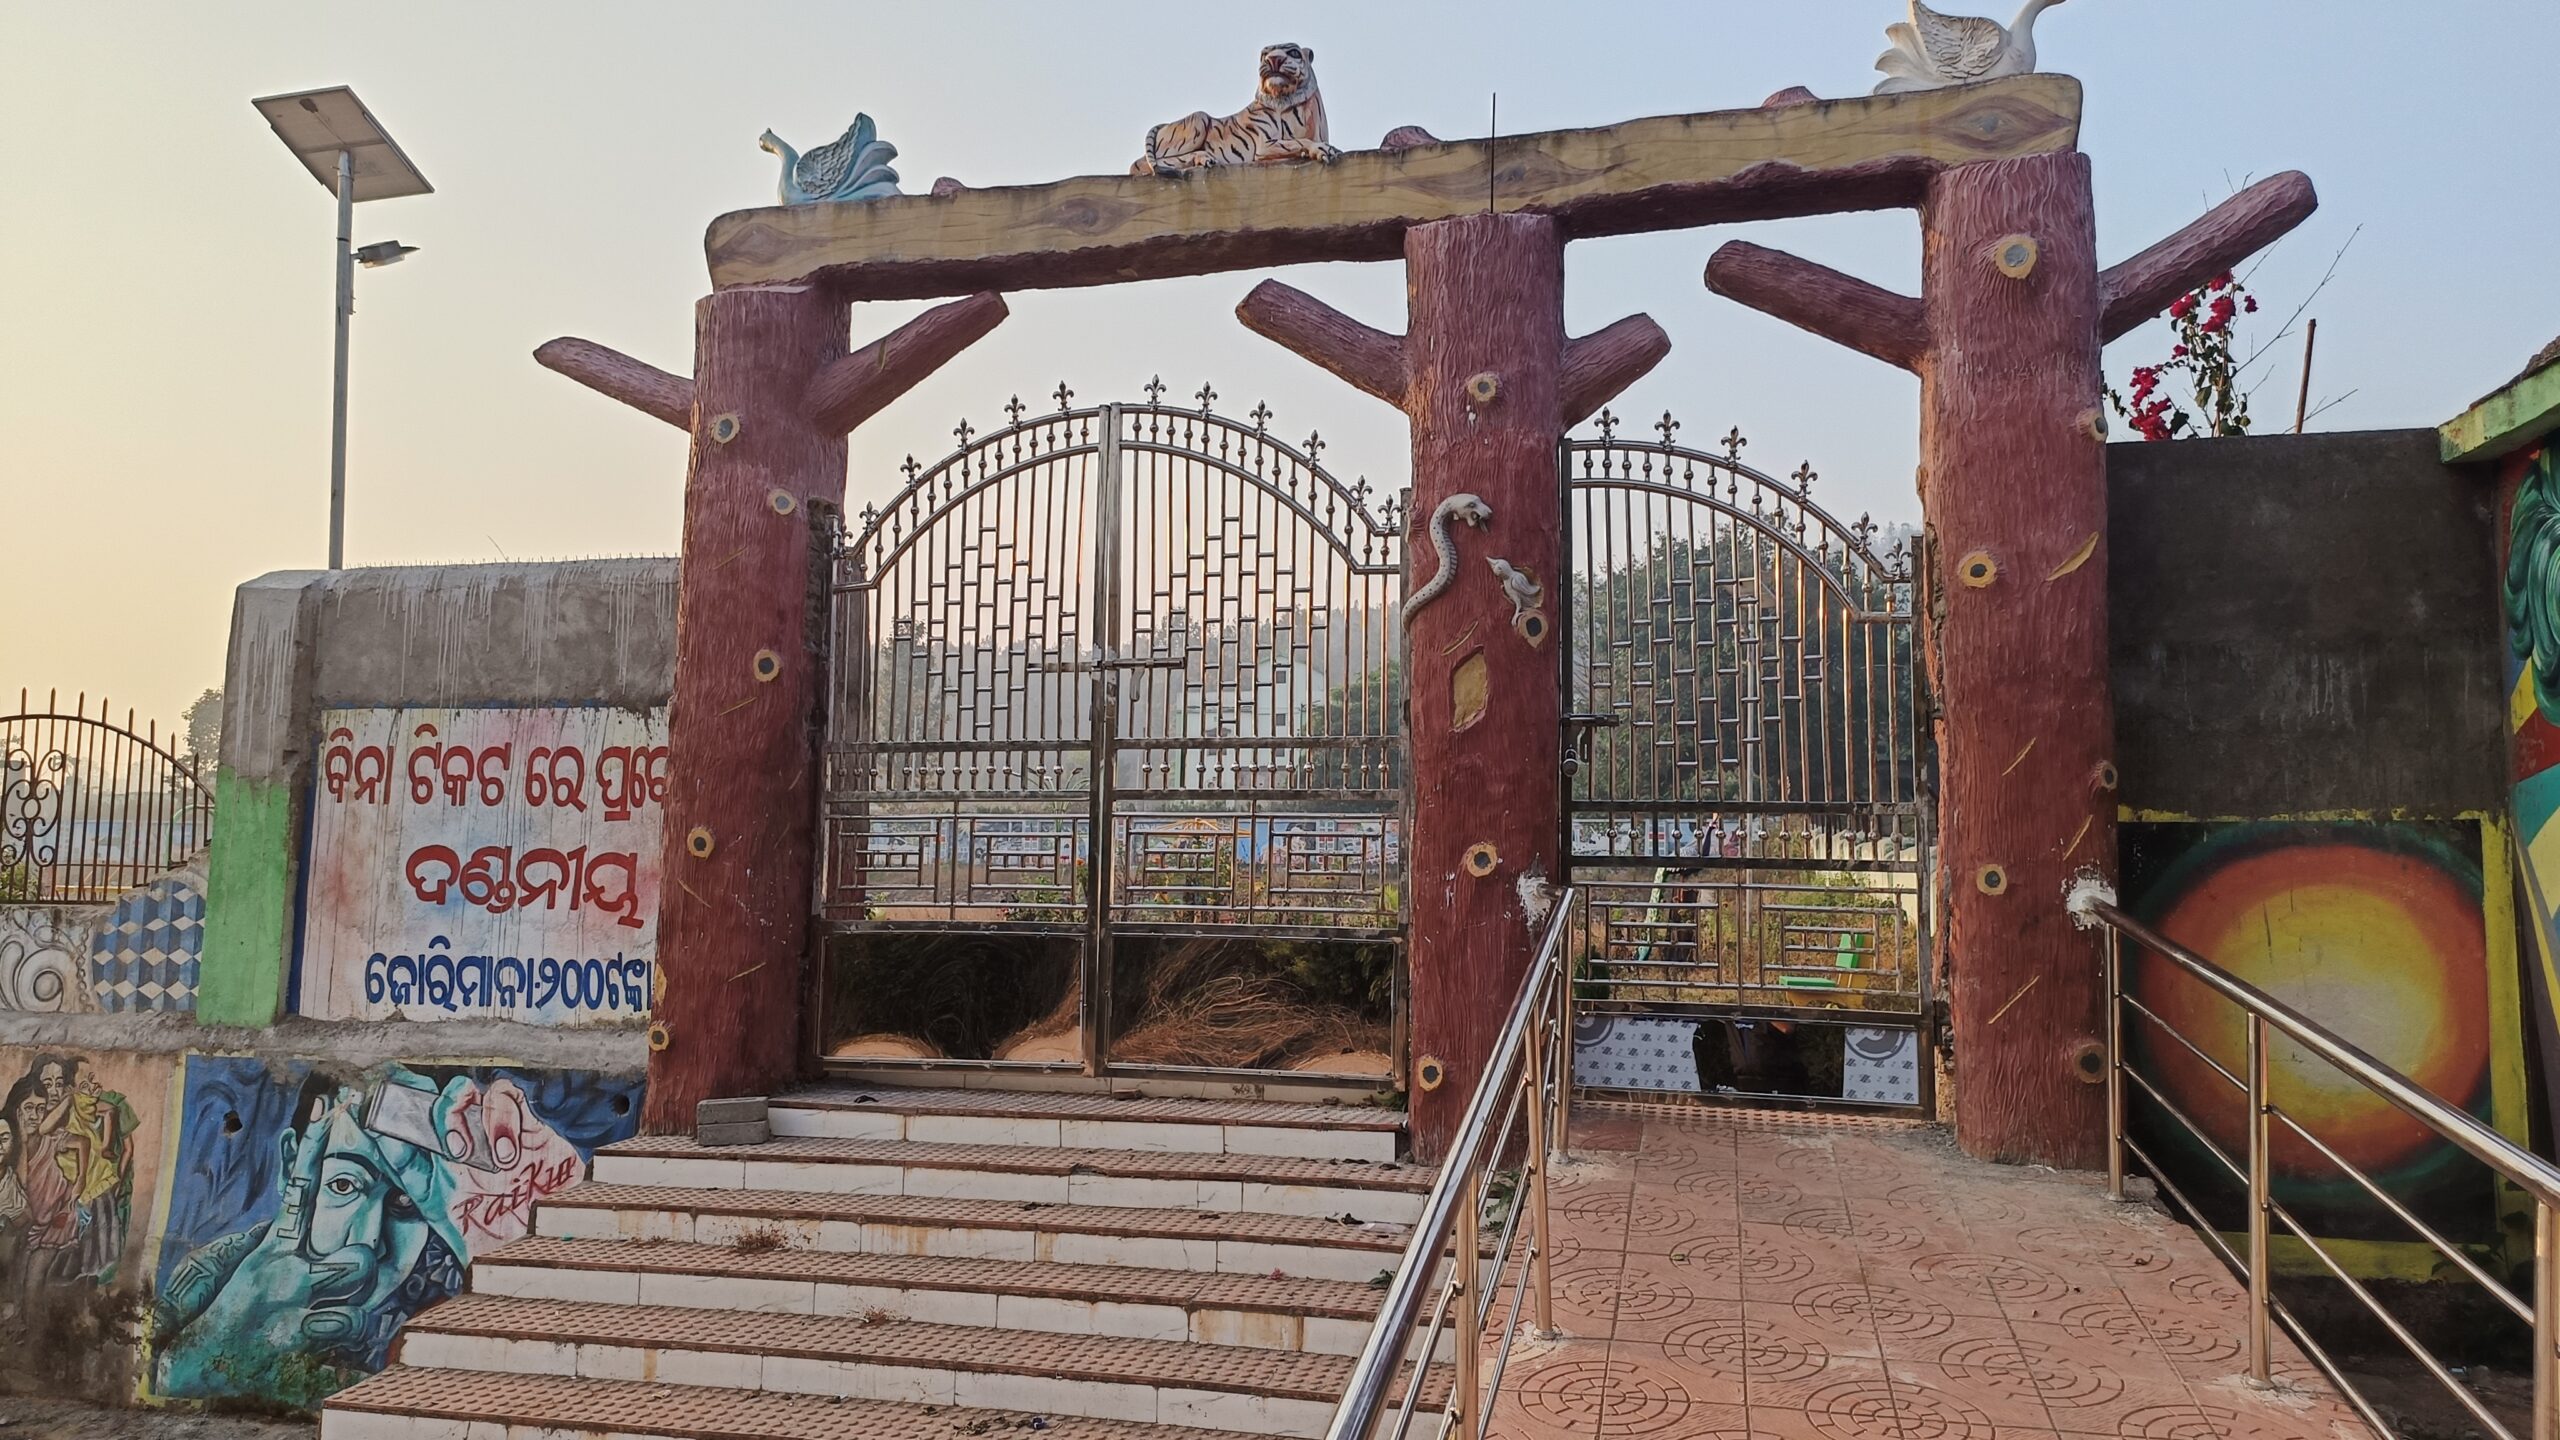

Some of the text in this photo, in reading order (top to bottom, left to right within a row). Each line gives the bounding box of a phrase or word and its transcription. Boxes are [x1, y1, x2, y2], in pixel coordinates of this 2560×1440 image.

[325, 723, 669, 822] ବିନା ଟିକଟ ରେ ପ୍ରବେ
